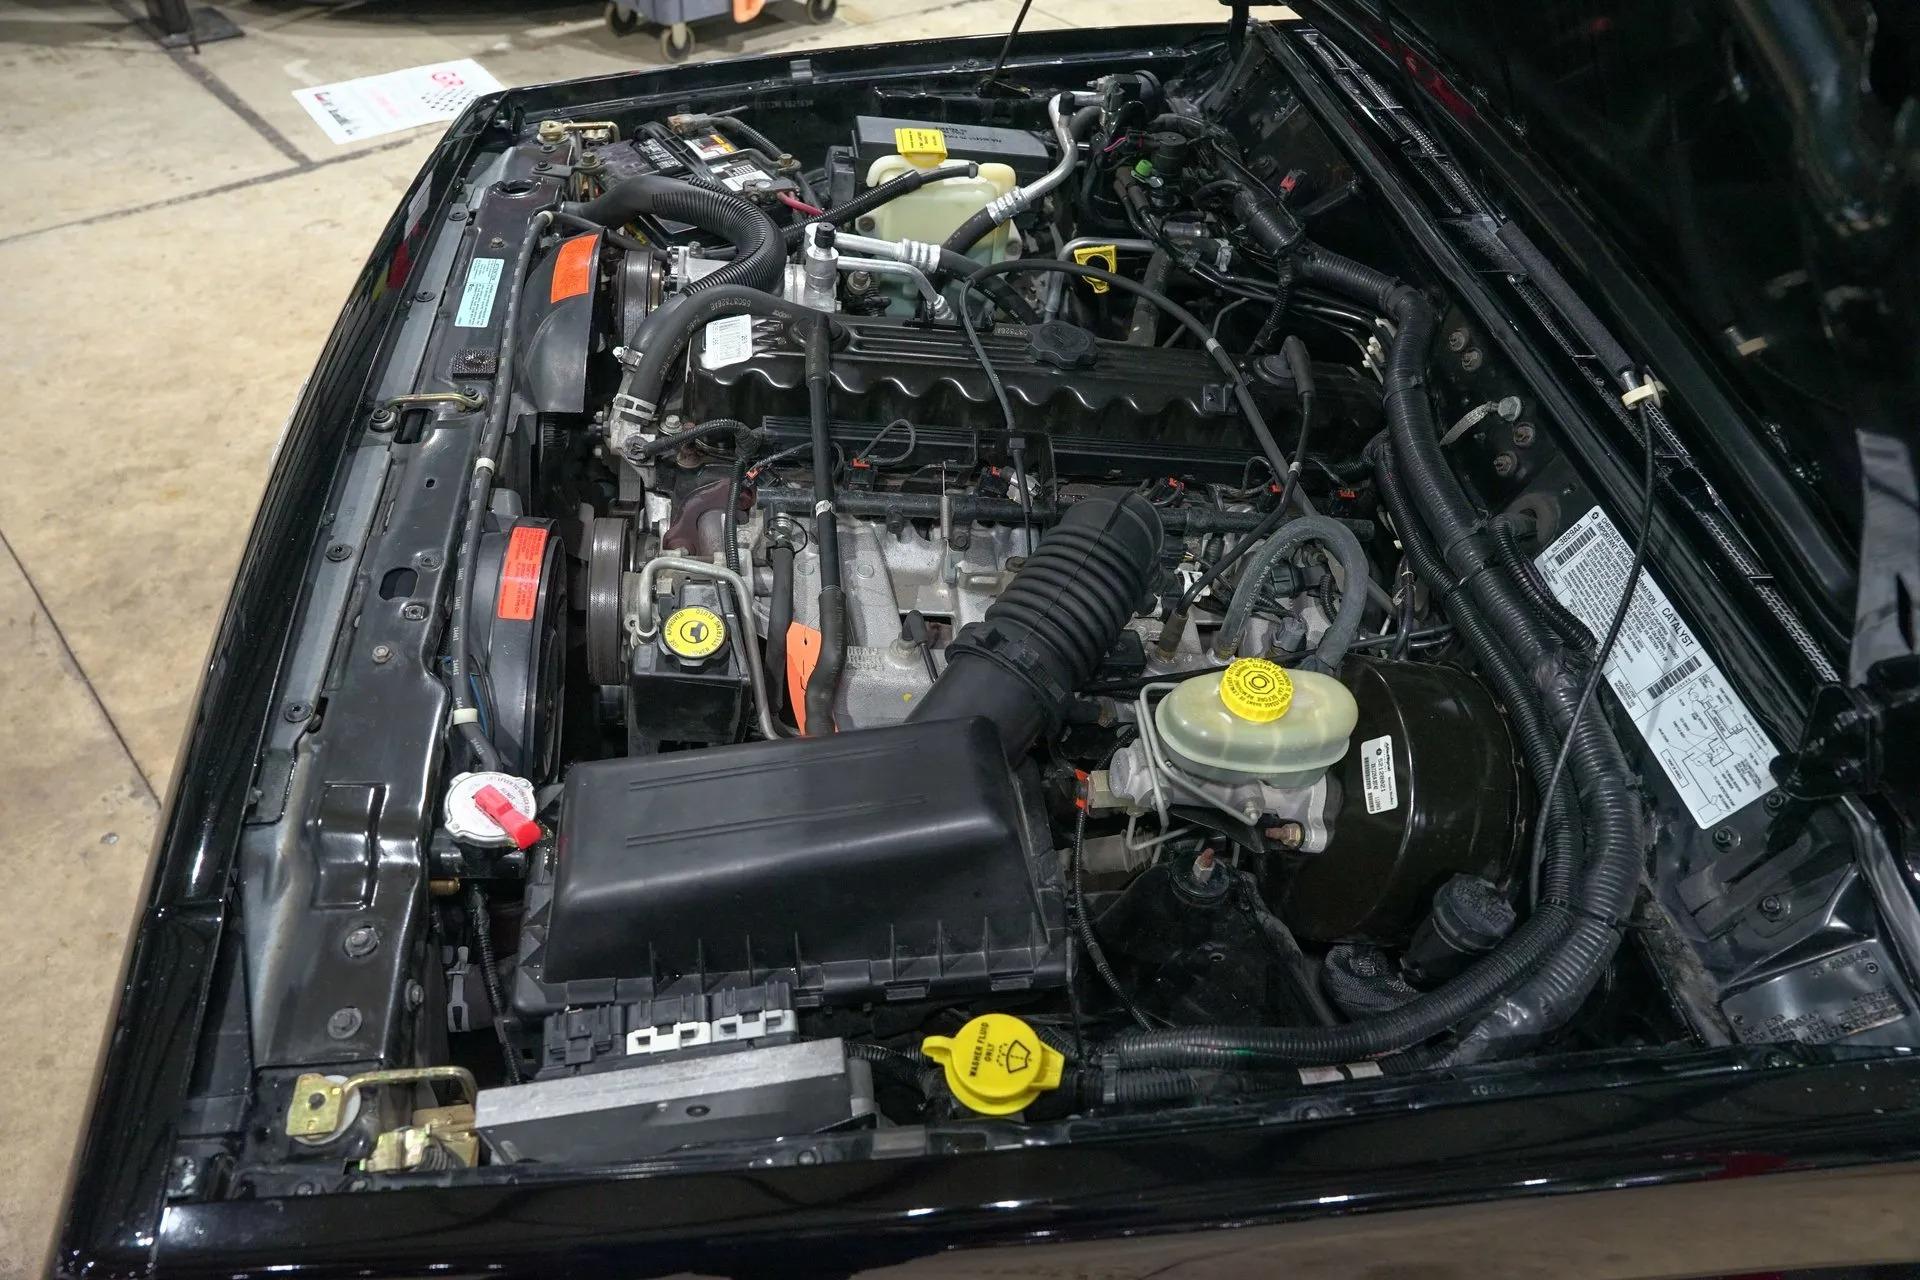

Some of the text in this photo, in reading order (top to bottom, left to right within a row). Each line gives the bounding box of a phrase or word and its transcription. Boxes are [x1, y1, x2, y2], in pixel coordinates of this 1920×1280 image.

[1595, 521, 1618, 550] IMPORTANT
[1615, 548, 1633, 570] VEHICLE
[1601, 516, 1621, 543] CHRYSLER
[1660, 606, 1694, 648] CATALYST
[968, 1021, 990, 1077] WASHER FLUID
[984, 1042, 995, 1062] ONLY
